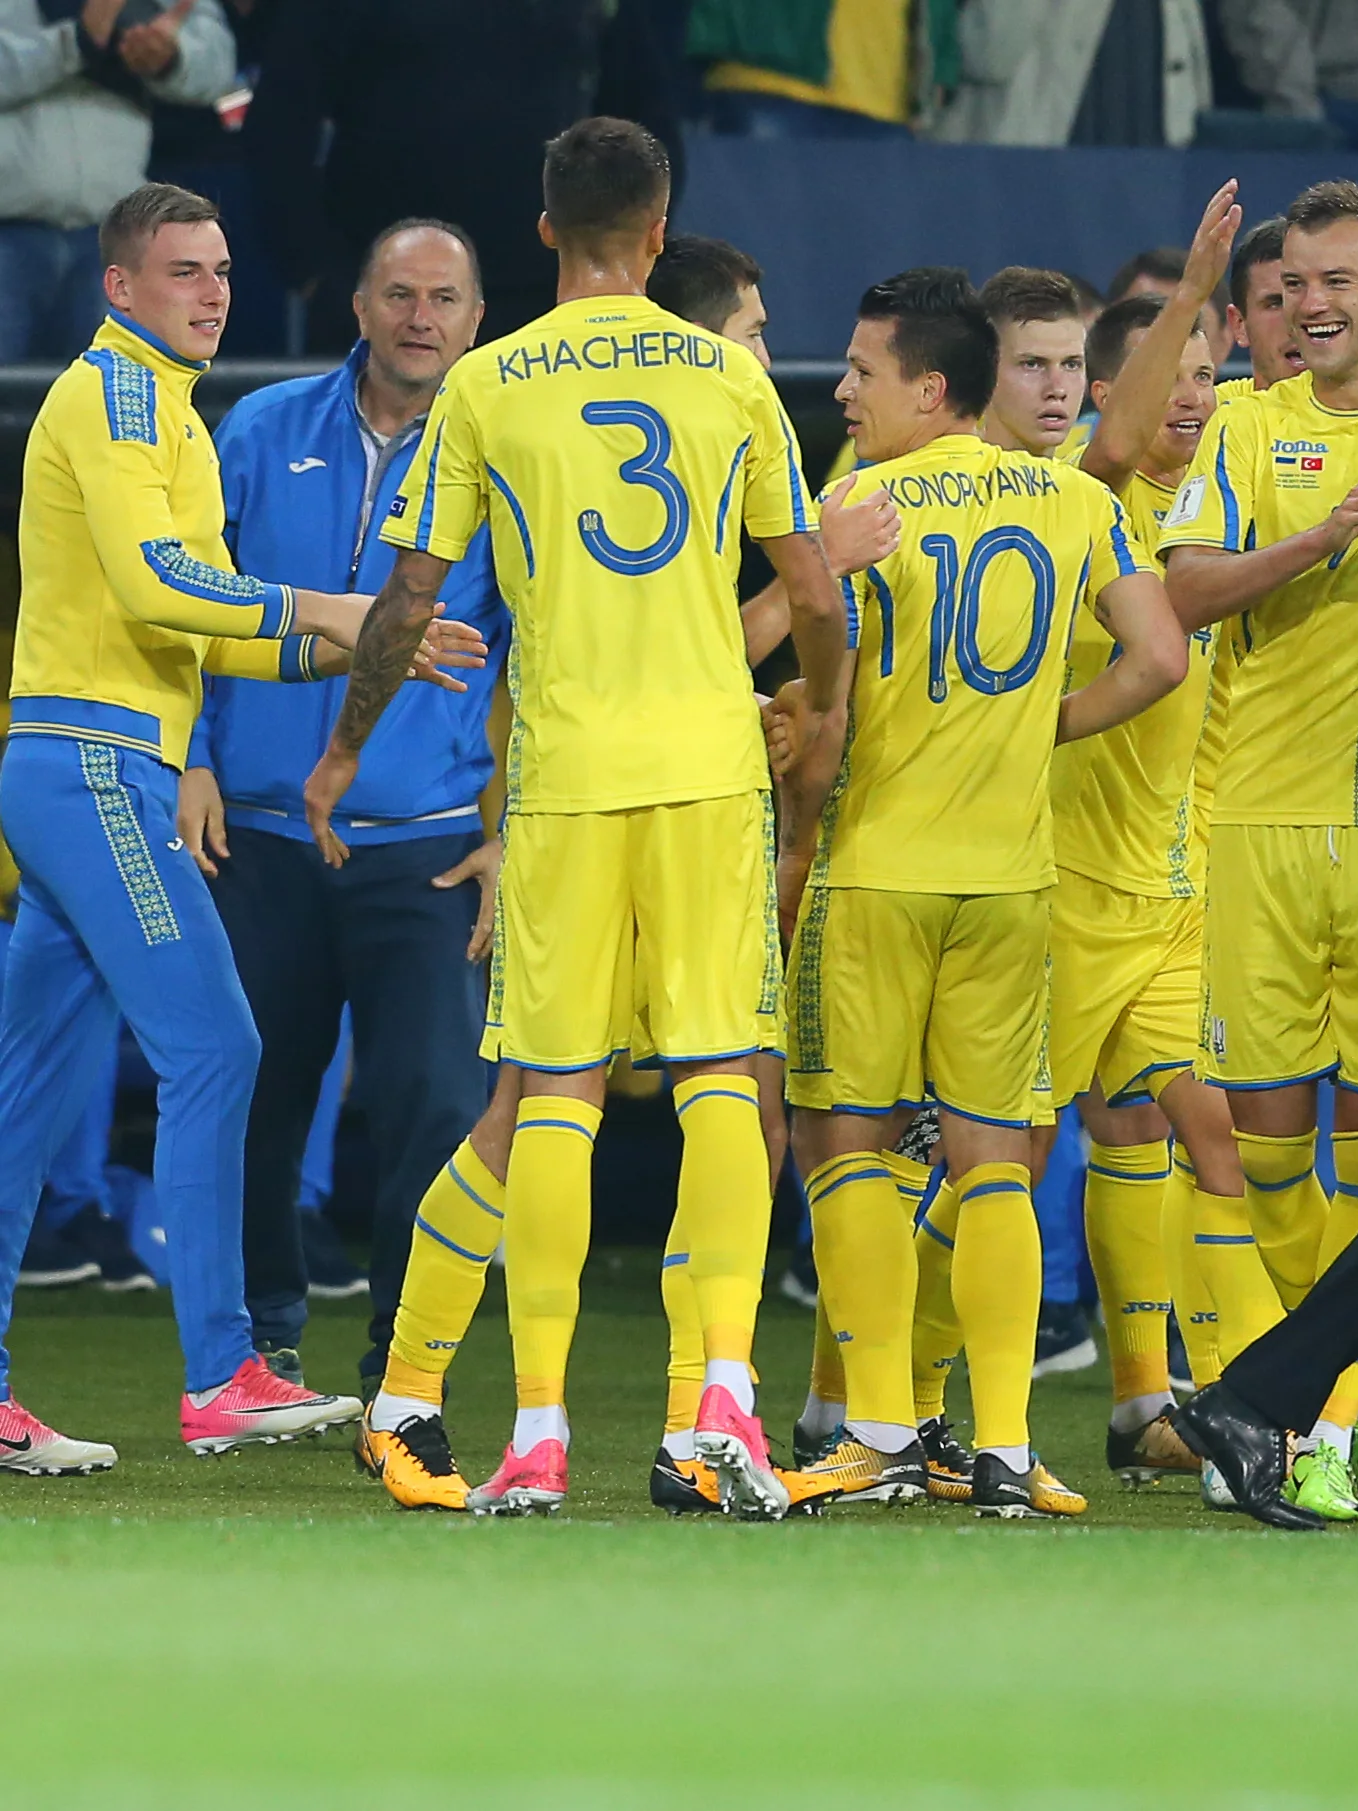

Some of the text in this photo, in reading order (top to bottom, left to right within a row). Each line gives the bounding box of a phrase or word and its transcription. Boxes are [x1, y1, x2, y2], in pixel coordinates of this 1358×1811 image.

[497, 331, 724, 384] KHACHERIDI
[577, 400, 690, 576] 3
[921, 525, 1056, 704] 10
